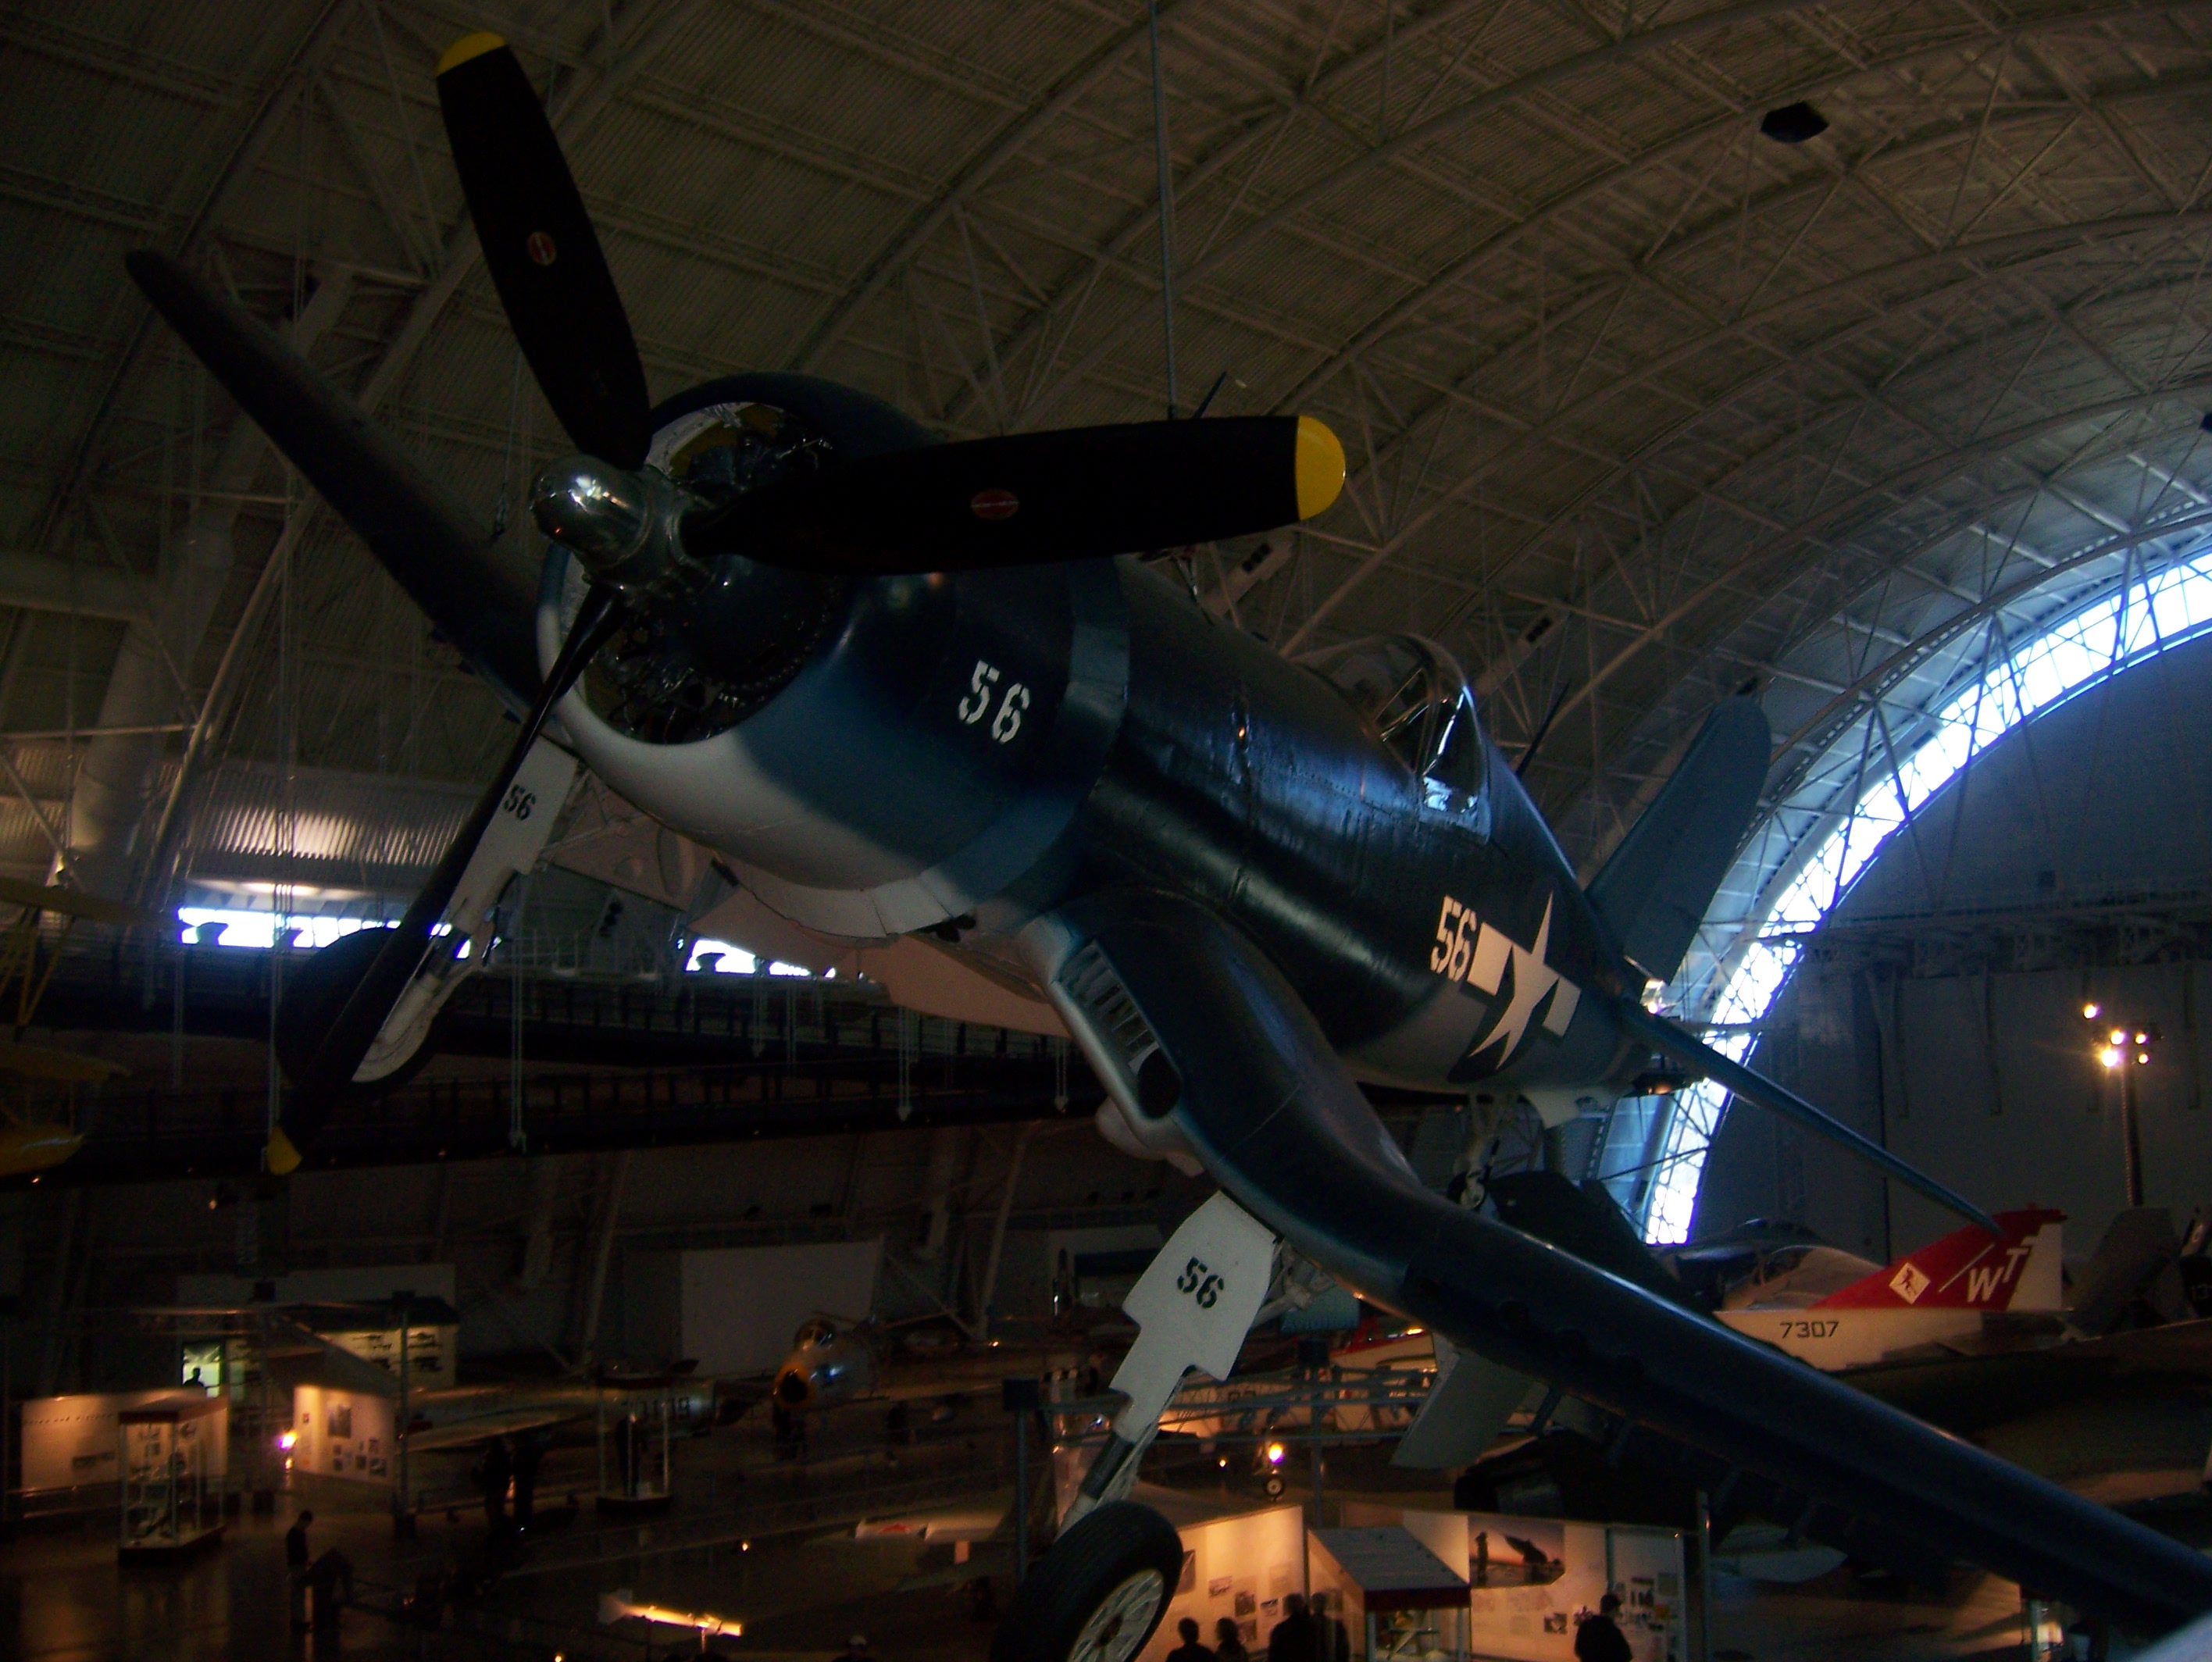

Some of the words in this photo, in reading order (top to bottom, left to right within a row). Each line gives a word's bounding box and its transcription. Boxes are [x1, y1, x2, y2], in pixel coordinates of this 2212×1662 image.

[958, 660, 1030, 744] 56
[504, 784, 537, 821] 56
[1430, 893, 1478, 983] 56
[1177, 1256, 1225, 1309] 56
[1779, 1320, 1839, 1339] 7307
